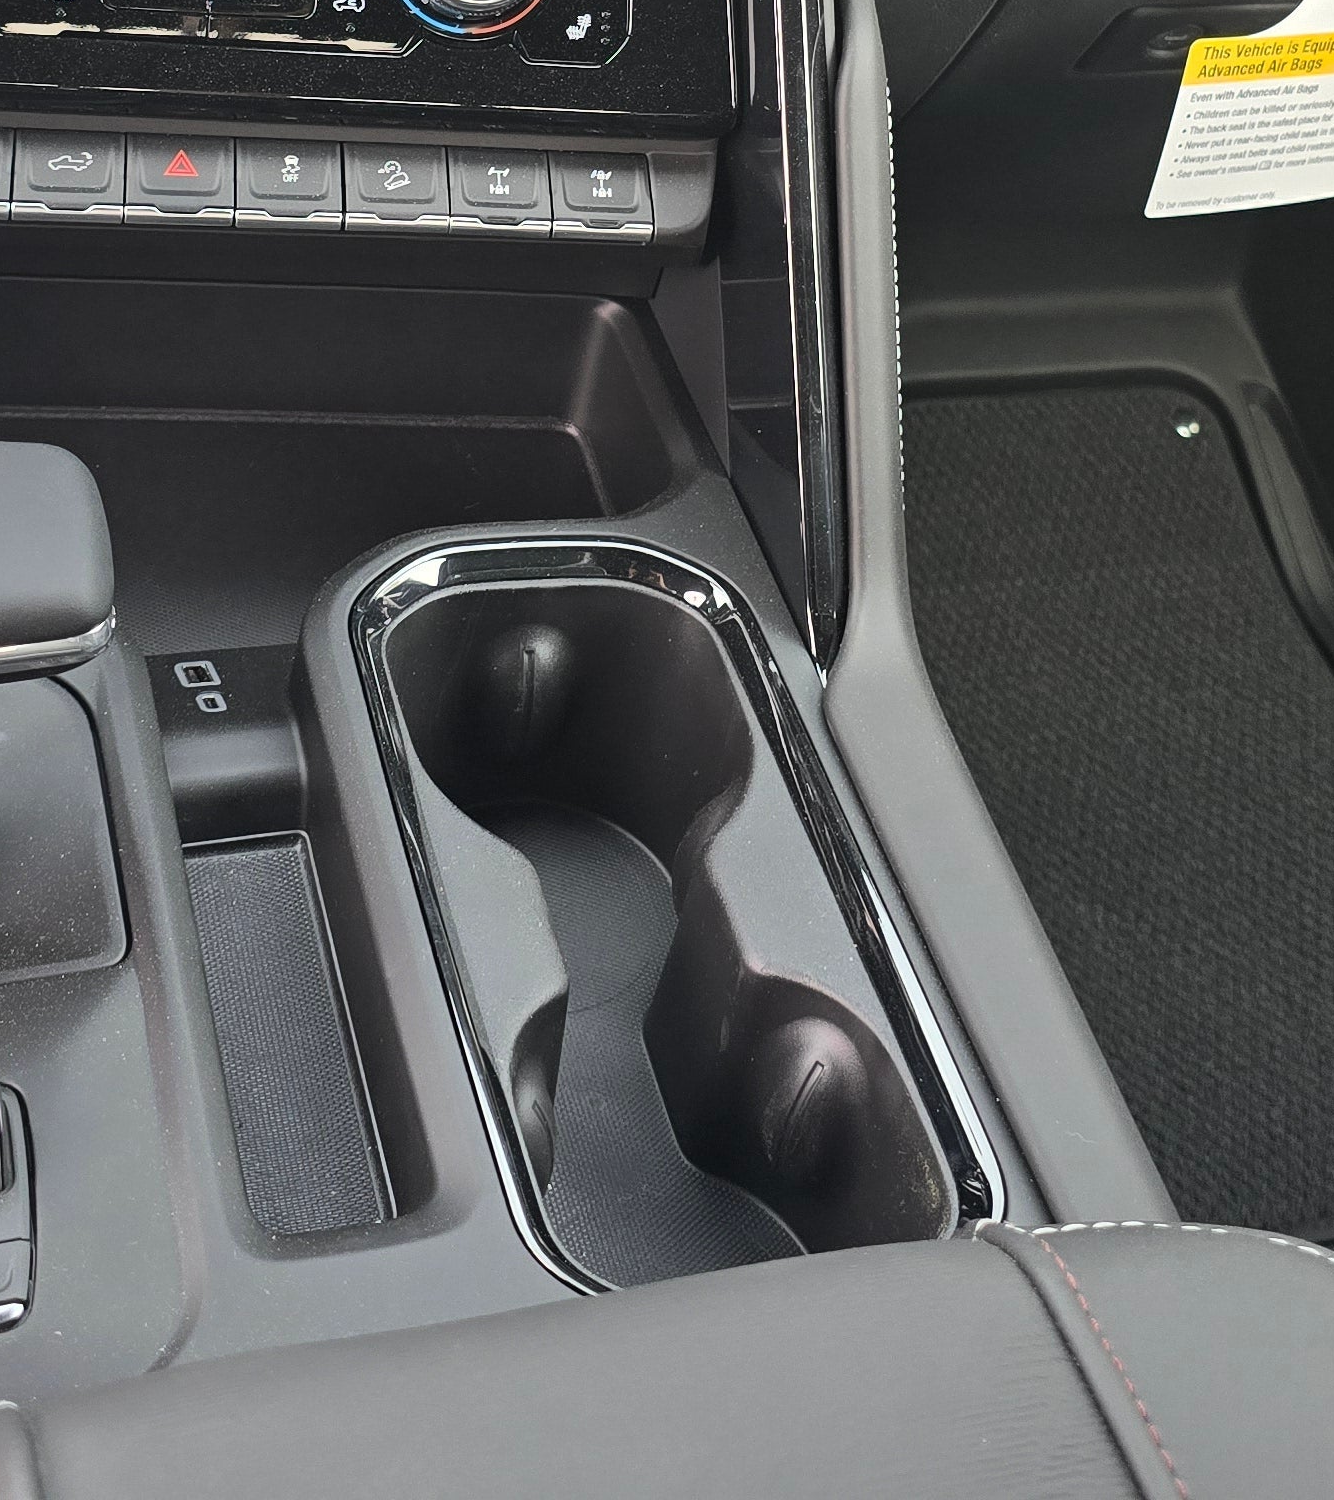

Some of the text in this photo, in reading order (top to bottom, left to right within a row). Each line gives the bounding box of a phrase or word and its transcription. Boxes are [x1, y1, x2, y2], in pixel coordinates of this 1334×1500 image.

[1204, 45, 1231, 60] This
[1237, 42, 1283, 57] Vehicle
[1287, 40, 1299, 54] is
[1197, 58, 1323, 78] Advanced Air Bags
[1190, 83, 1320, 102] Even with Advanced Air Bags
[1193, 108, 1230, 120] Children
[1231, 108, 1248, 117] can
[1249, 106, 1261, 116] be
[1262, 103, 1286, 114] killed
[1287, 103, 1298, 111] or
[1190, 126, 1205, 135] The
[1206, 124, 1227, 133] back
[1228, 122, 1246, 131] seat
[1248, 121, 1255, 129] is
[1256, 119, 1271, 128] the
[1321, 113, 1333, 122] for
[1184, 140, 1211, 150] Never
[1210, 139, 1225, 148] put
[1279, 131, 1301, 140] child
[1320, 128, 1328, 136] in
[1180, 154, 1210, 164] Always
[1212, 153, 1227, 161] use
[1228, 150, 1246, 160] seat
[1269, 146, 1285, 155] and
[1286, 144, 1307, 153] child
[283, 173, 299, 182] OFF
[1176, 170, 1192, 179] See
[1194, 167, 1226, 177] owner's
[1227, 163, 1258, 173] manual
[1273, 160, 1284, 168] for
[1285, 158, 1306, 167] more
[1156, 202, 1165, 210] To
[1166, 200, 1176, 209] be
[1177, 197, 1211, 208] removed
[1211, 196, 1222, 206] by
